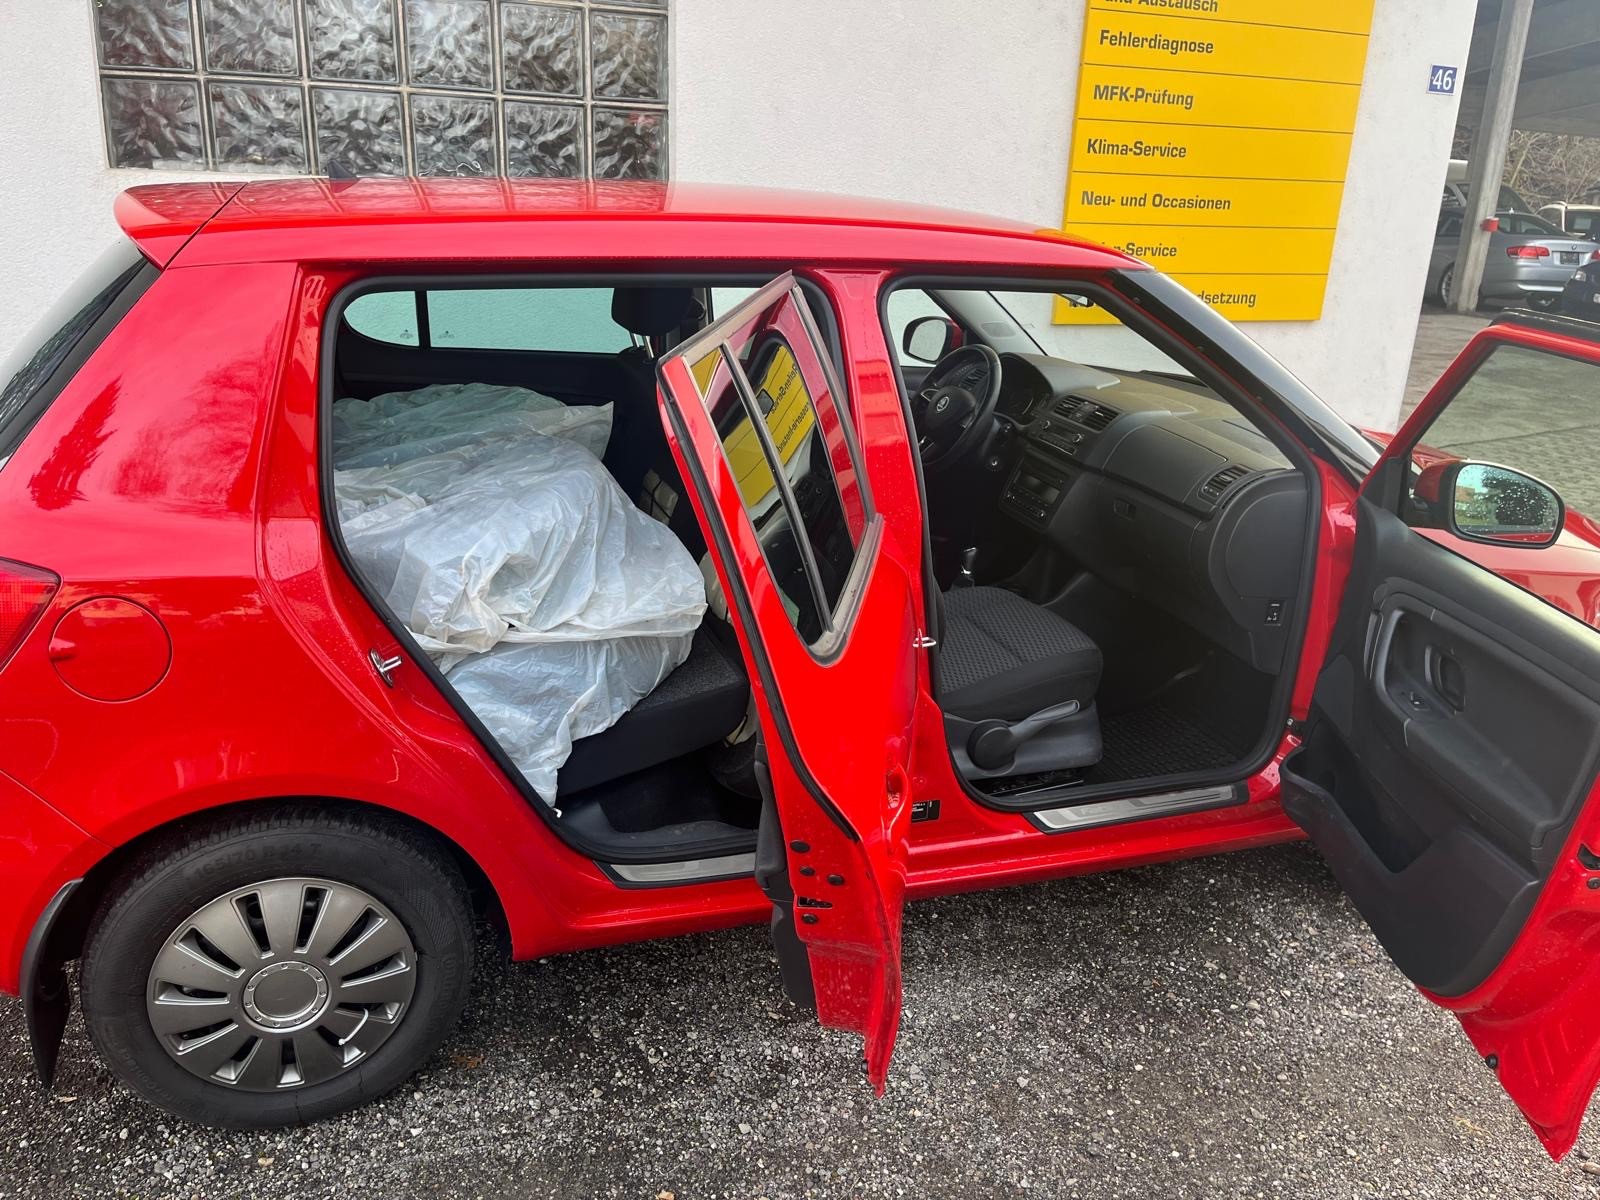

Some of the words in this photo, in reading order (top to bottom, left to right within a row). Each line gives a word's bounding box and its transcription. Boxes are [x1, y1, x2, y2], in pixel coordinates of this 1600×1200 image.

[1099, 29, 1215, 55] Fehlerdiagnose
[1432, 69, 1454, 90] 46
[1093, 84, 1194, 110] MFK-Prüfung
[1087, 138, 1188, 158] Klima-Service
[1081, 191, 1116, 206] Neu-
[1120, 193, 1147, 207] und
[1151, 193, 1232, 210] Occasionen
[1102, 241, 1178, 257] -Service
